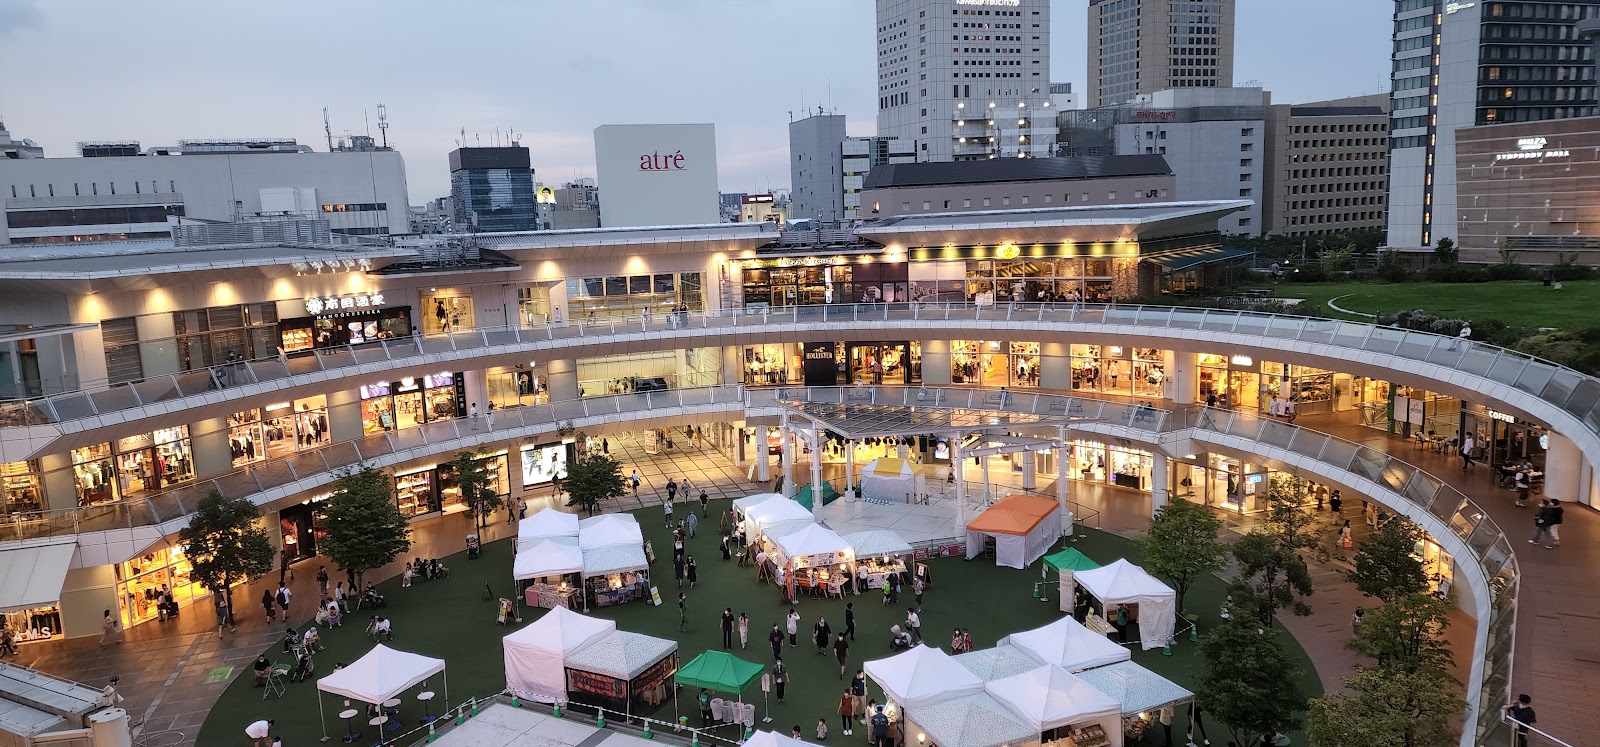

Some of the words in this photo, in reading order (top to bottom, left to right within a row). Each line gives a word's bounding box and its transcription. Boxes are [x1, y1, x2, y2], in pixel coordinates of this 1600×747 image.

[1518, 137, 1547, 146] MUZA
[640, 150, 686, 170] atré
[1496, 152, 1543, 161] SYMPHONY
[1545, 150, 1571, 158] HALL
[1146, 189, 1158, 198] JR
[1488, 410, 1515, 424] COFFEE
